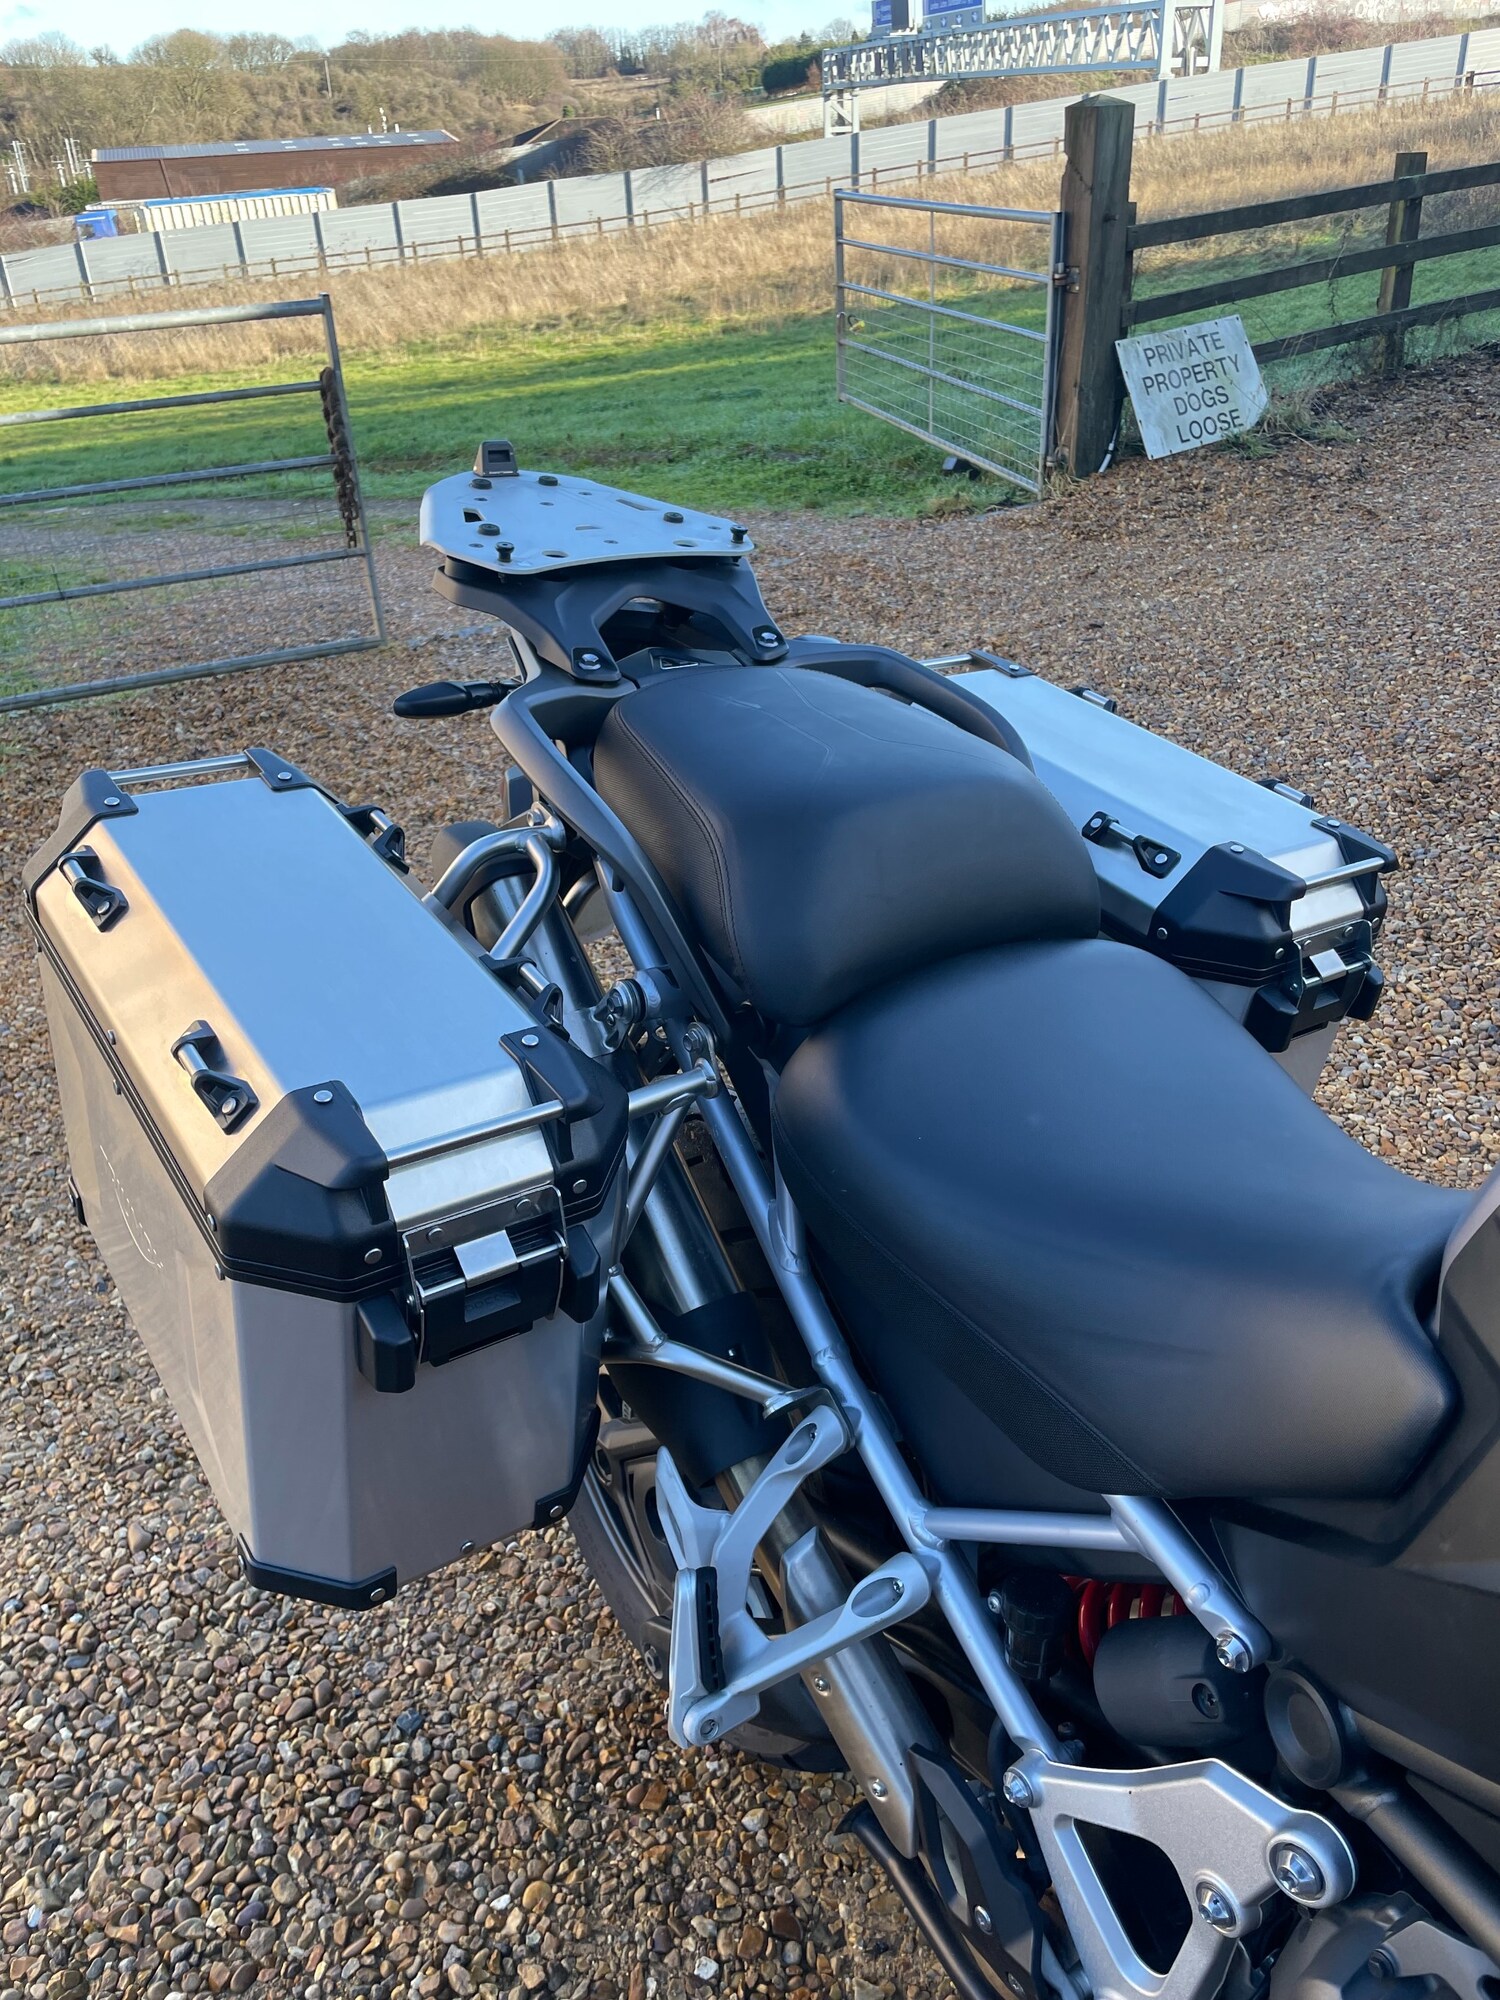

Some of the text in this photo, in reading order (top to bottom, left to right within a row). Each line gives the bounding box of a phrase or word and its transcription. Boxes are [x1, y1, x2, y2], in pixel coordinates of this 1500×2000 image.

[1143, 331, 1225, 367] PRIVATE
[1142, 354, 1240, 396] PROPERTY
[1173, 385, 1230, 416] DOGS
[1176, 409, 1244, 443] LOOSE
